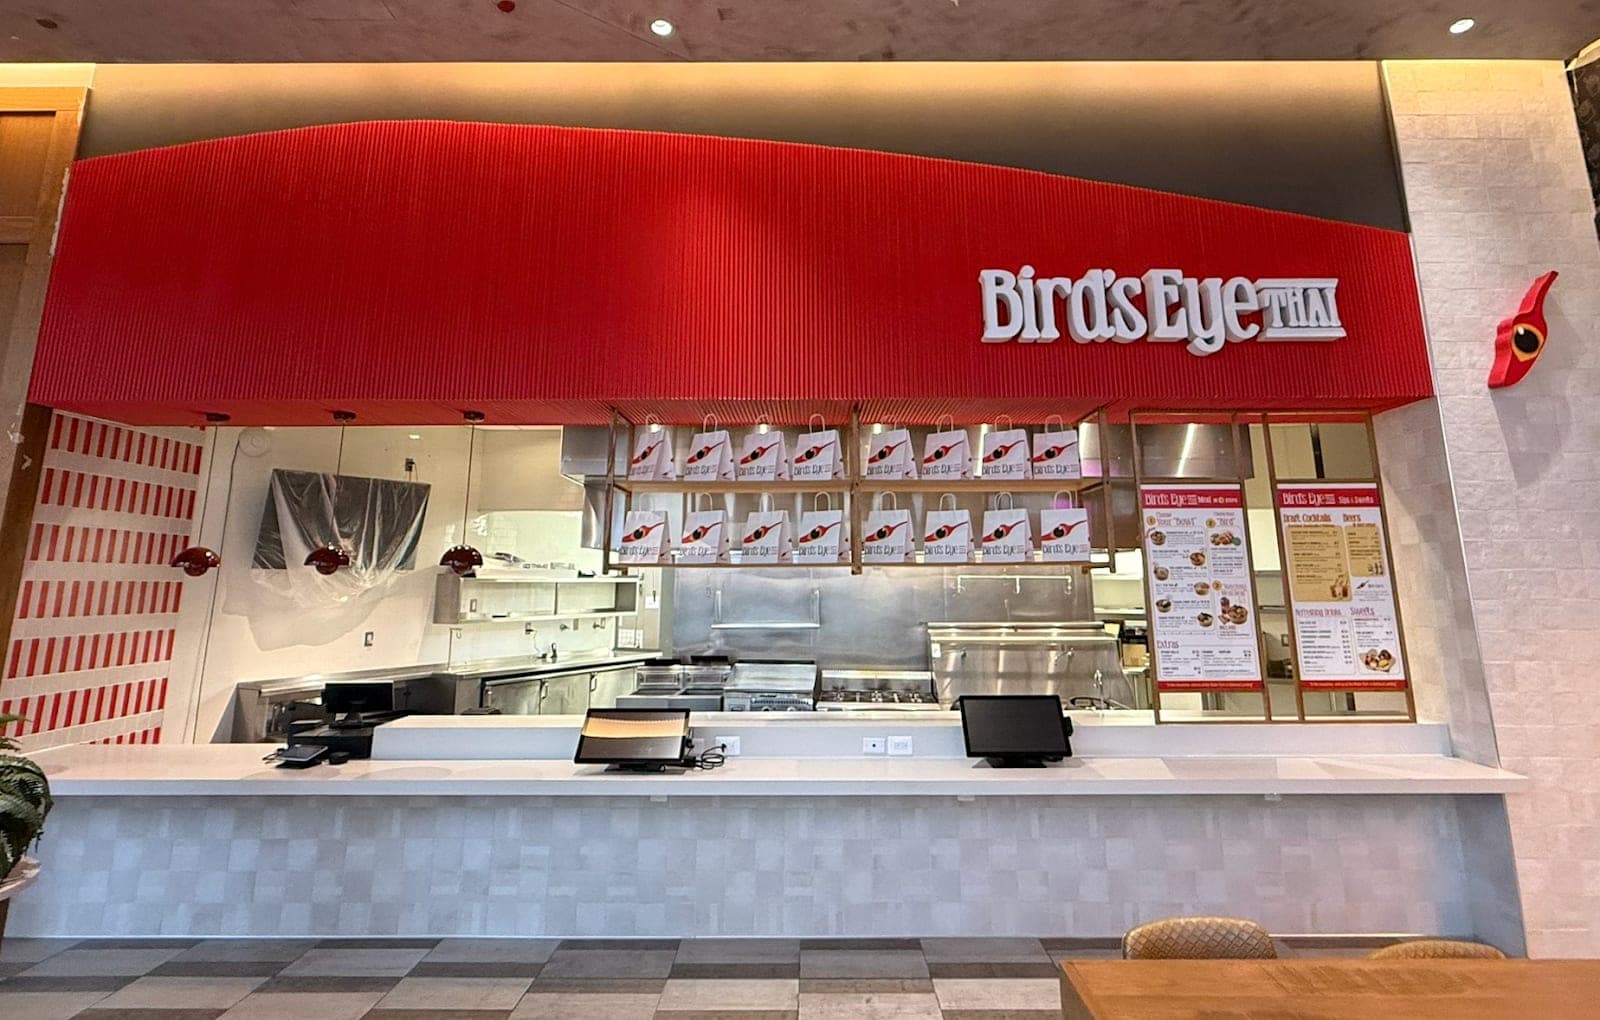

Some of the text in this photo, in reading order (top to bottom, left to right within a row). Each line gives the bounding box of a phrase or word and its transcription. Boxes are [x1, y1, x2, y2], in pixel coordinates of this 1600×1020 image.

[979, 265, 1344, 356] Bird's Eye THAI
